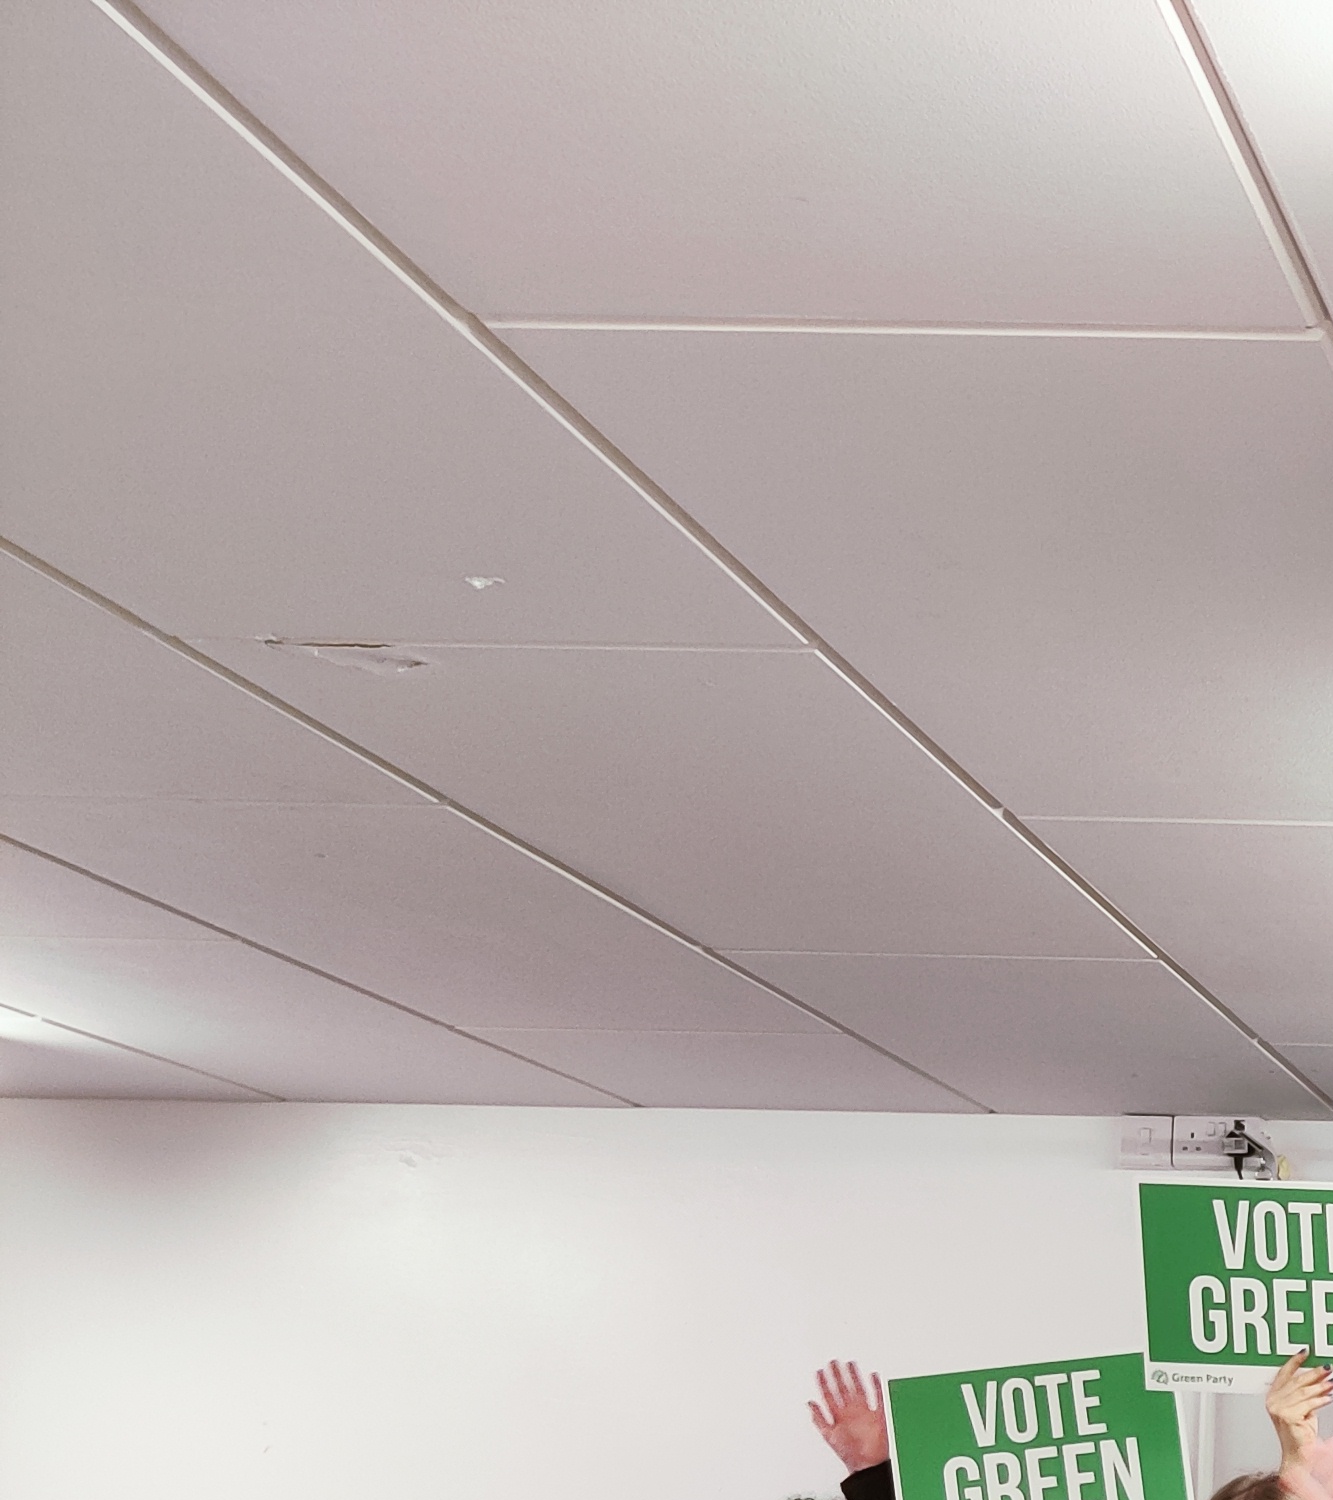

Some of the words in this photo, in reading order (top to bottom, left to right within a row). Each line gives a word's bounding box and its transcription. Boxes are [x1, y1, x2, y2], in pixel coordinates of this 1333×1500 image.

[1171, 1373, 1203, 1383] Green
[1206, 1374, 1234, 1386] Party
[960, 1369, 1108, 1448] VOTE
